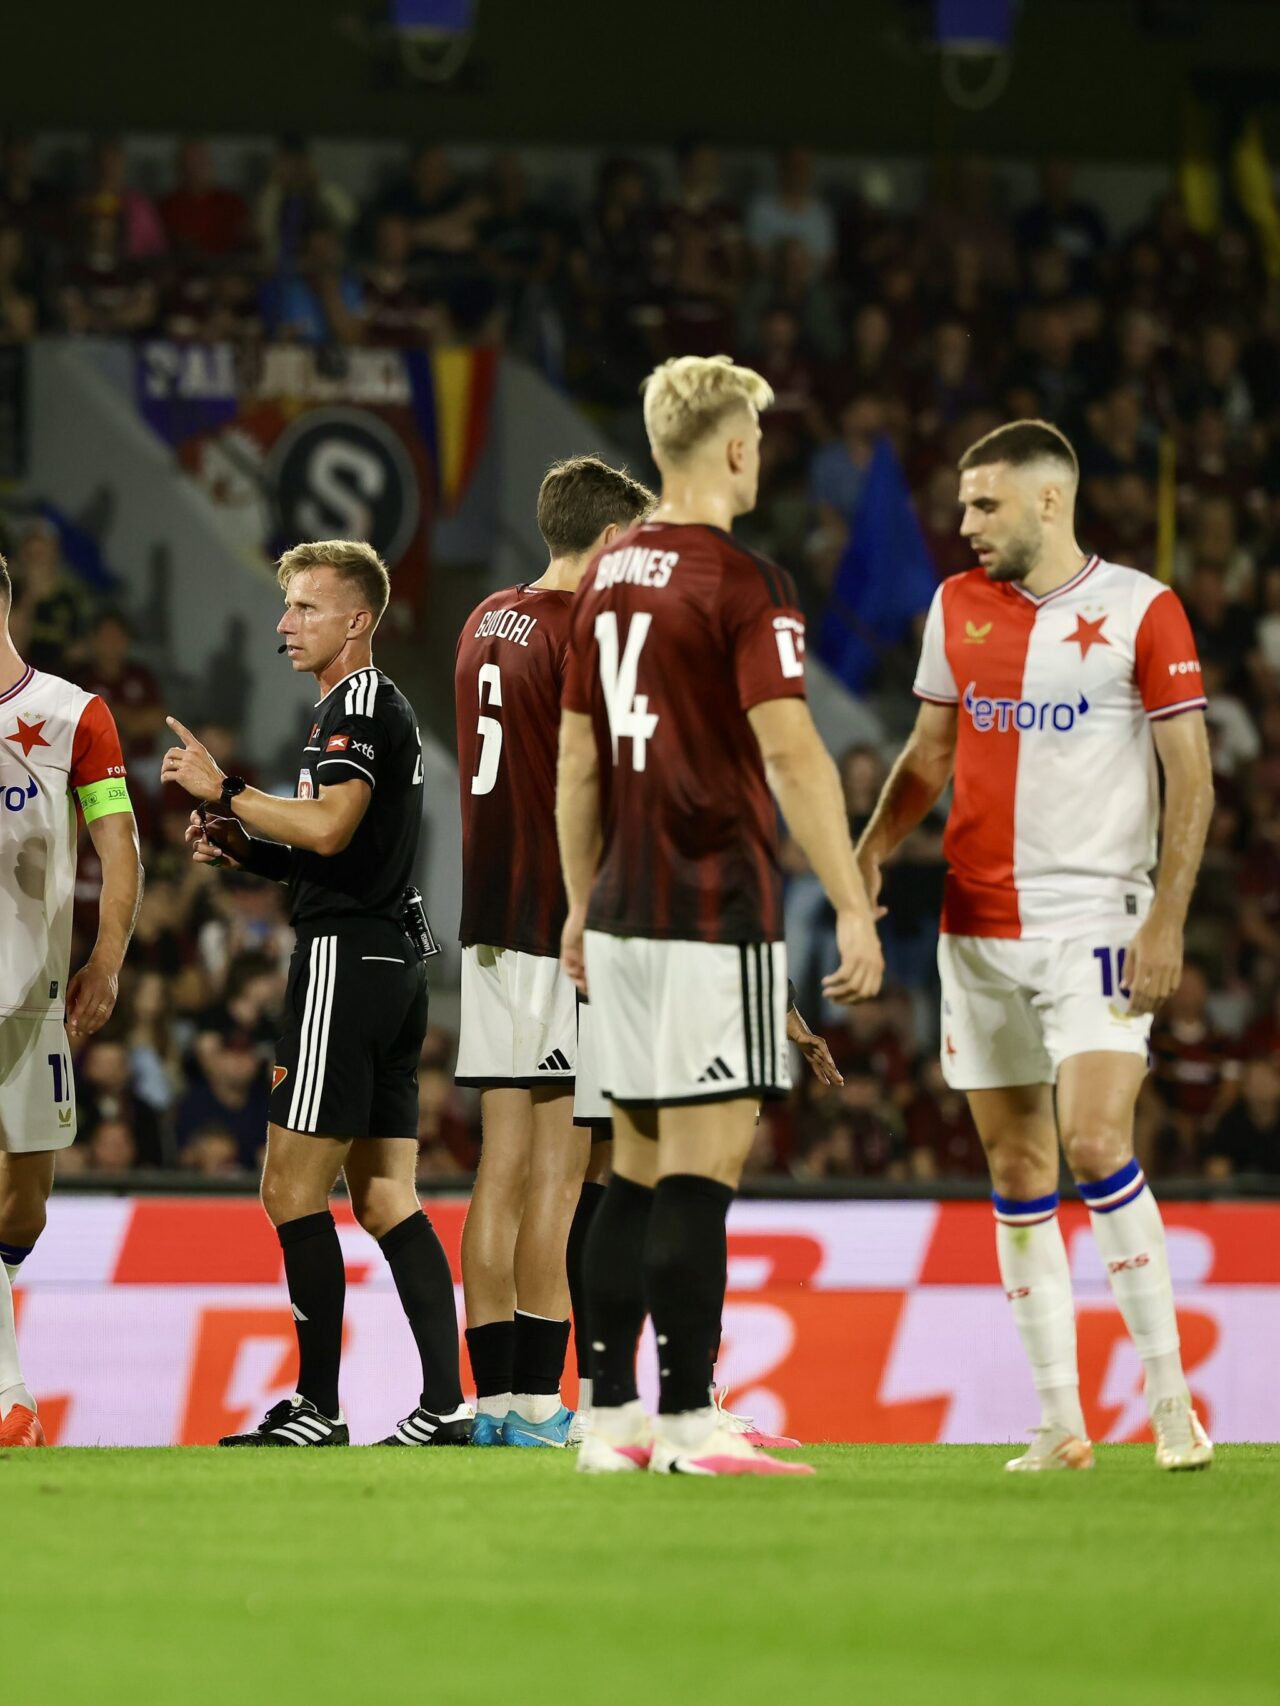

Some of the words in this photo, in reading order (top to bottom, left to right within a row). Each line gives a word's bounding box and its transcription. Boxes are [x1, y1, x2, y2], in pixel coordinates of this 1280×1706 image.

[293, 438, 386, 548] S
[471, 663, 503, 795] 6
[595, 611, 659, 772] 14
